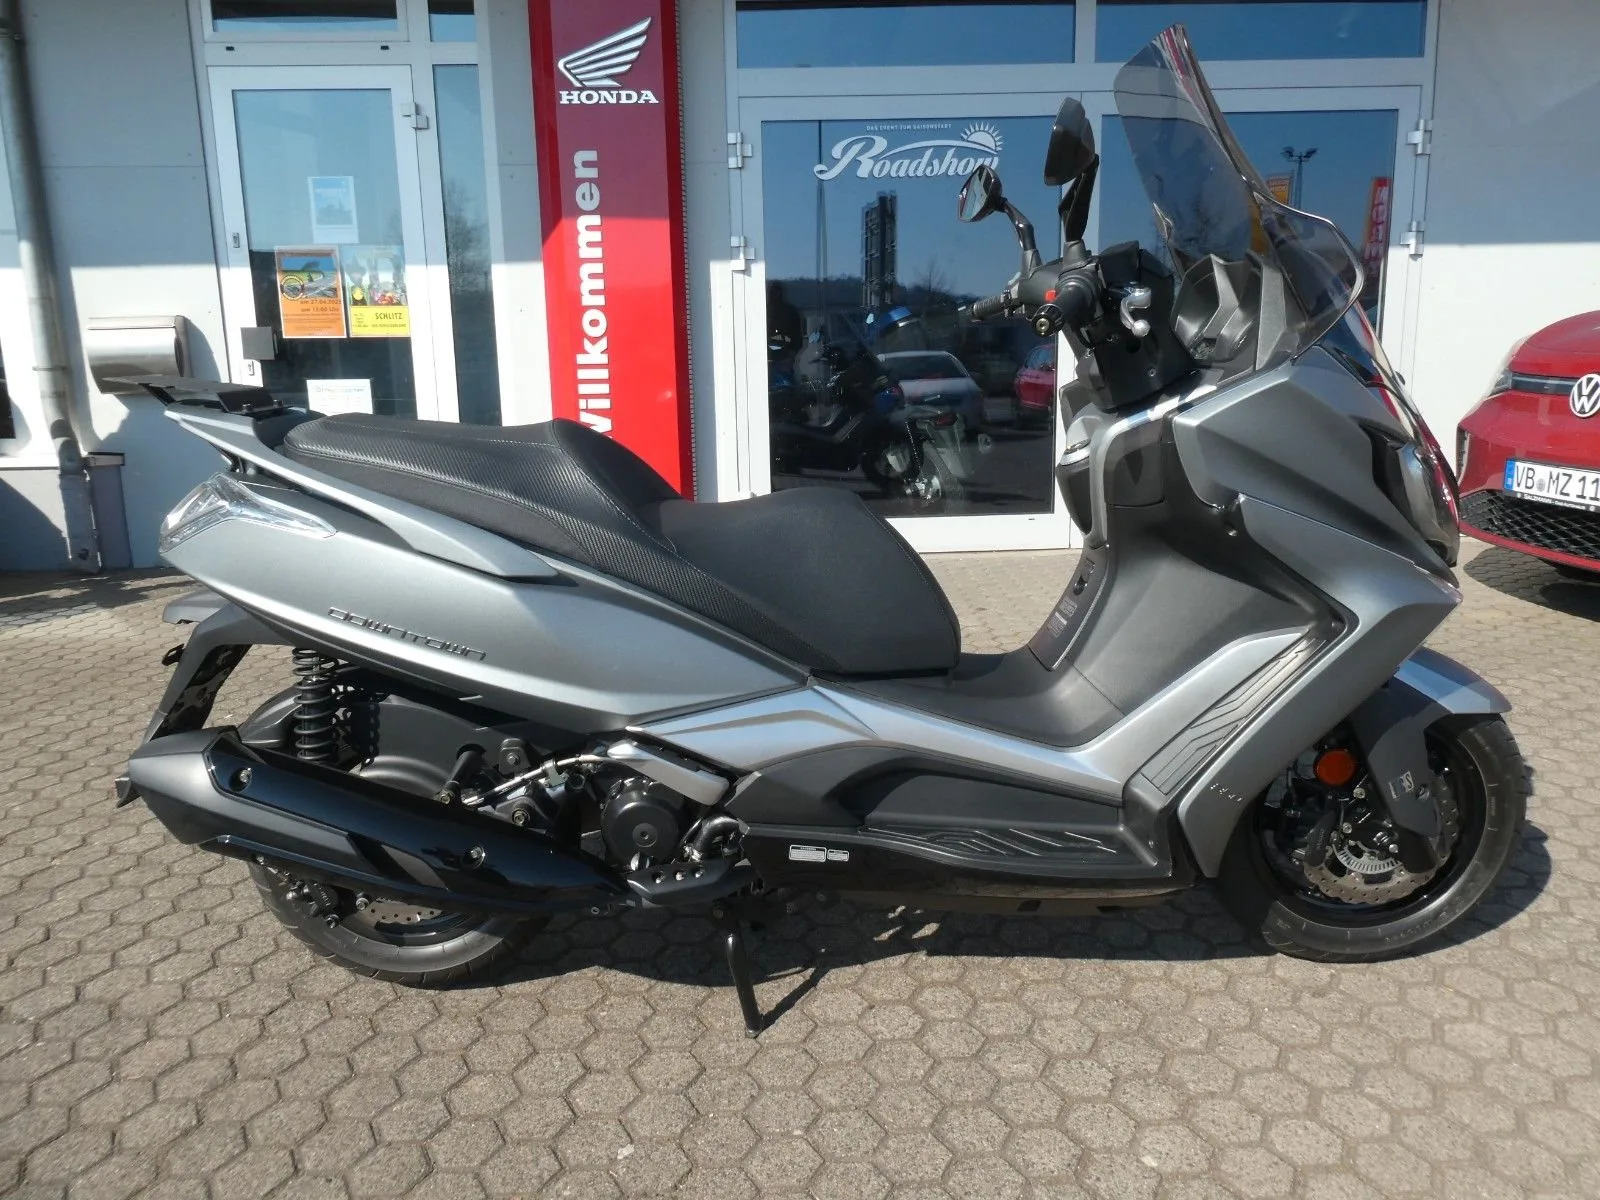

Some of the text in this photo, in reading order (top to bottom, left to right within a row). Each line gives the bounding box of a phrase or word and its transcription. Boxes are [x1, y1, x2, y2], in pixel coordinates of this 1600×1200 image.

[559, 90, 659, 104] HONDA
[1516, 465, 1536, 490] VB
[1547, 470, 1573, 498] MZ
[327, 606, 487, 661] DOWNTOWN
